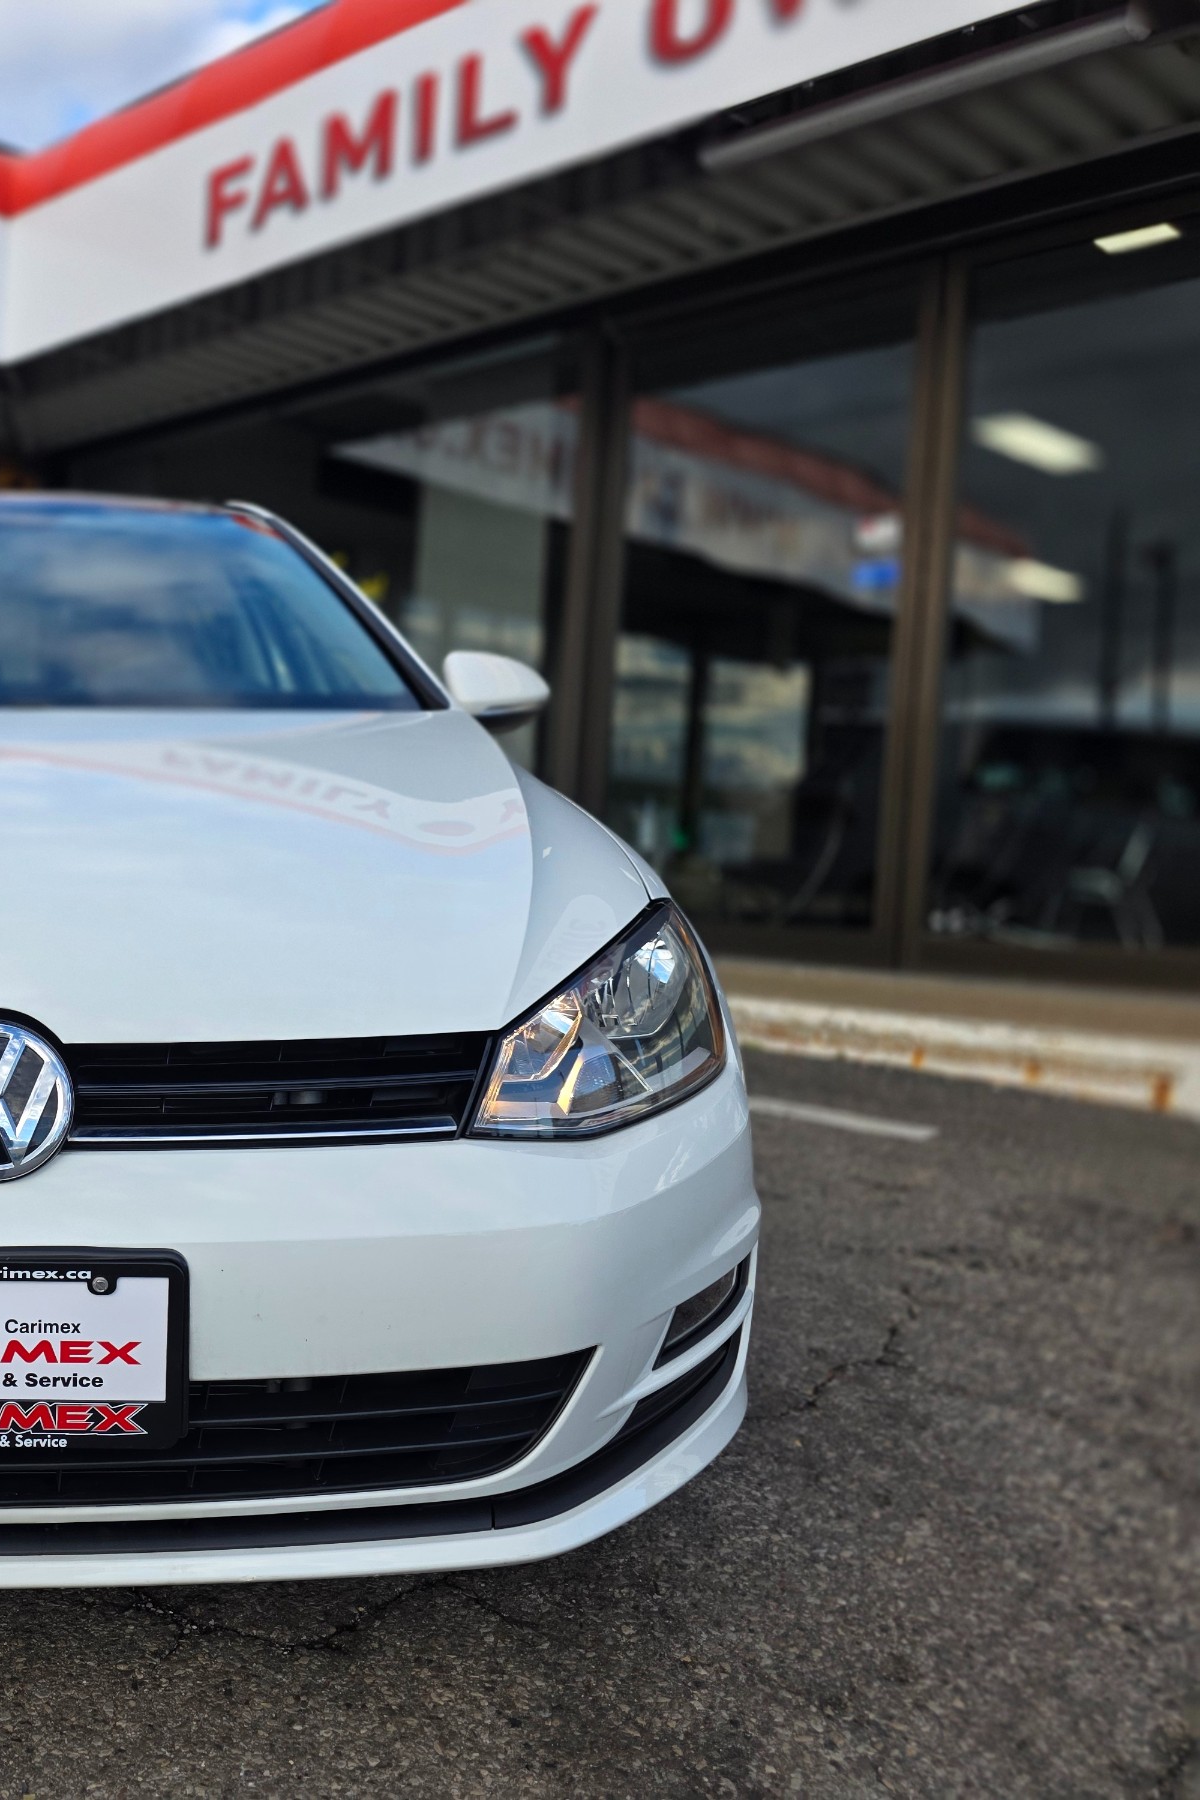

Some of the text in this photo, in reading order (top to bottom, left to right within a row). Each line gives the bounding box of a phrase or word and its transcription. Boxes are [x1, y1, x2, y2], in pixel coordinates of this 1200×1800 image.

[204, 3, 598, 250] FAMILY
[4, 1318, 81, 1334] Carimex
[2, 1372, 18, 1388] &
[24, 1372, 104, 1388] Service
[0, 1434, 11, 1448] &
[14, 1434, 68, 1448] Service
